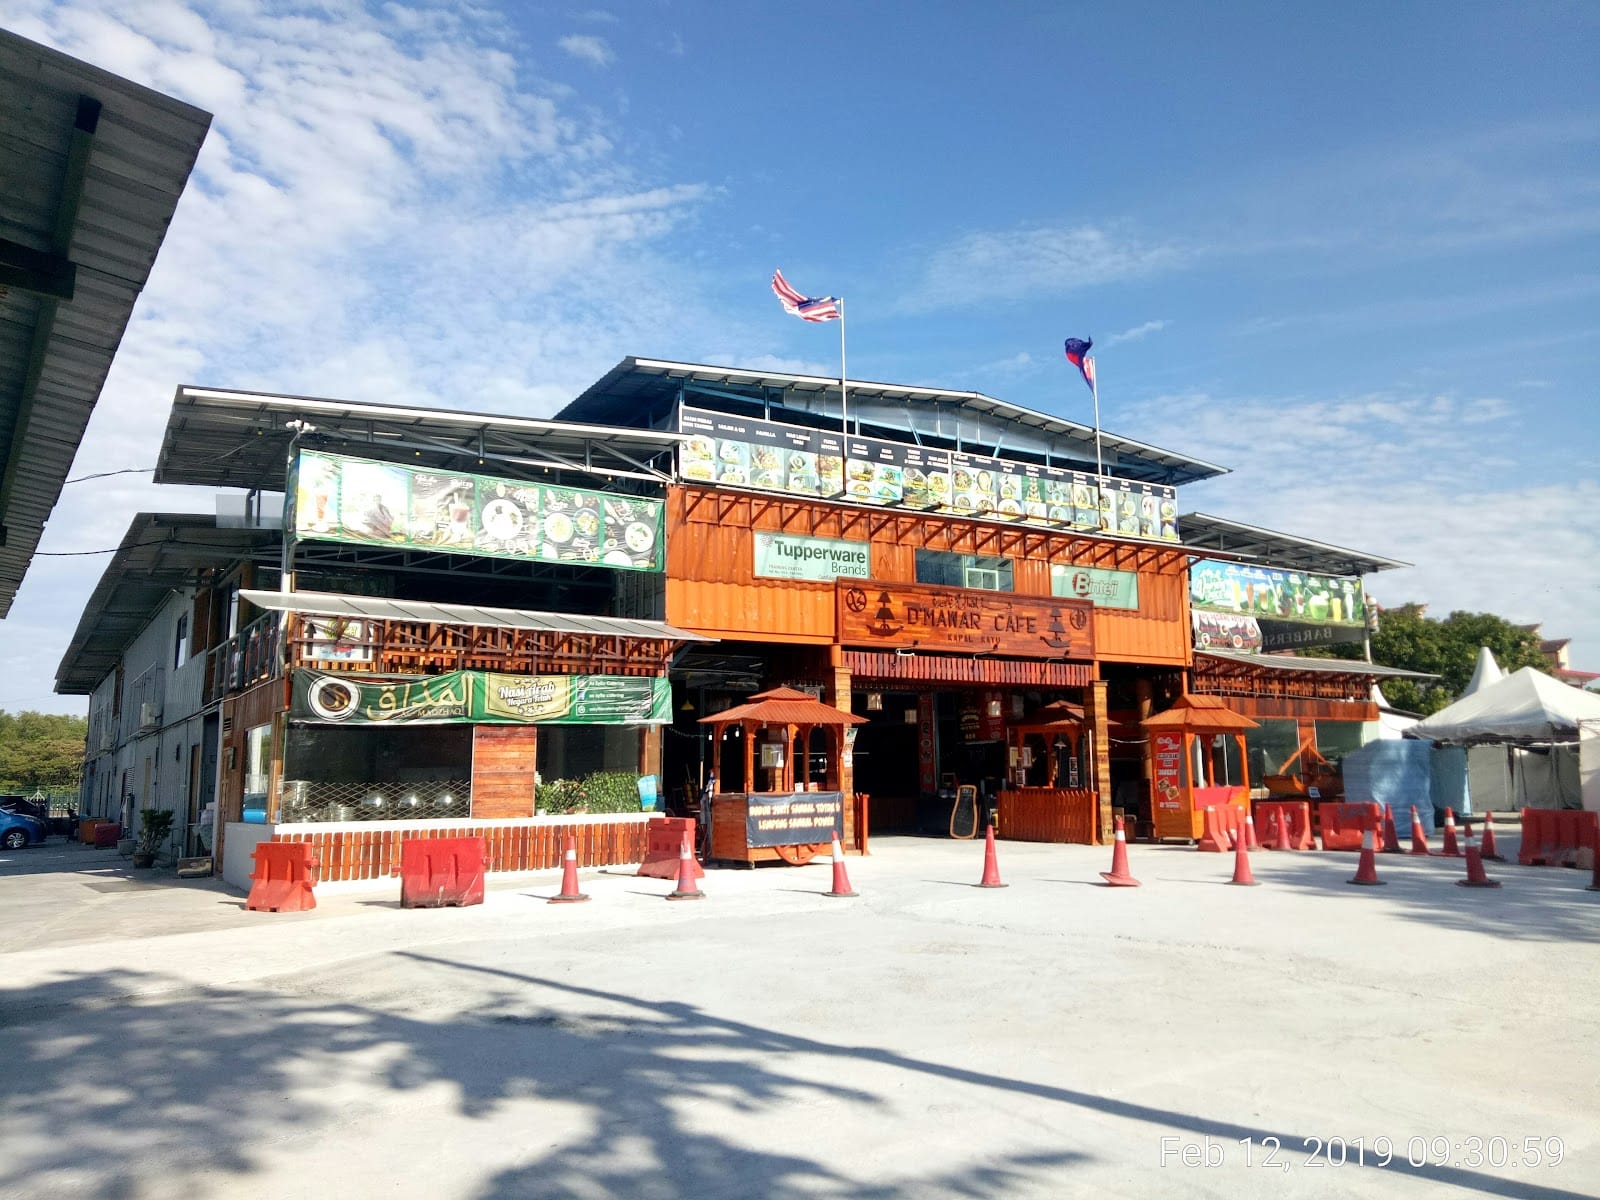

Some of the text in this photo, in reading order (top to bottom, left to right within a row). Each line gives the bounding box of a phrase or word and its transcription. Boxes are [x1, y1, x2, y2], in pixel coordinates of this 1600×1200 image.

[775, 540, 866, 563] Tupperware
[831, 562, 867, 576] Brands
[993, 614, 1037, 634] CAFE
[947, 633, 974, 643] KAPAL
[498, 681, 556, 698] Nasi Arab
